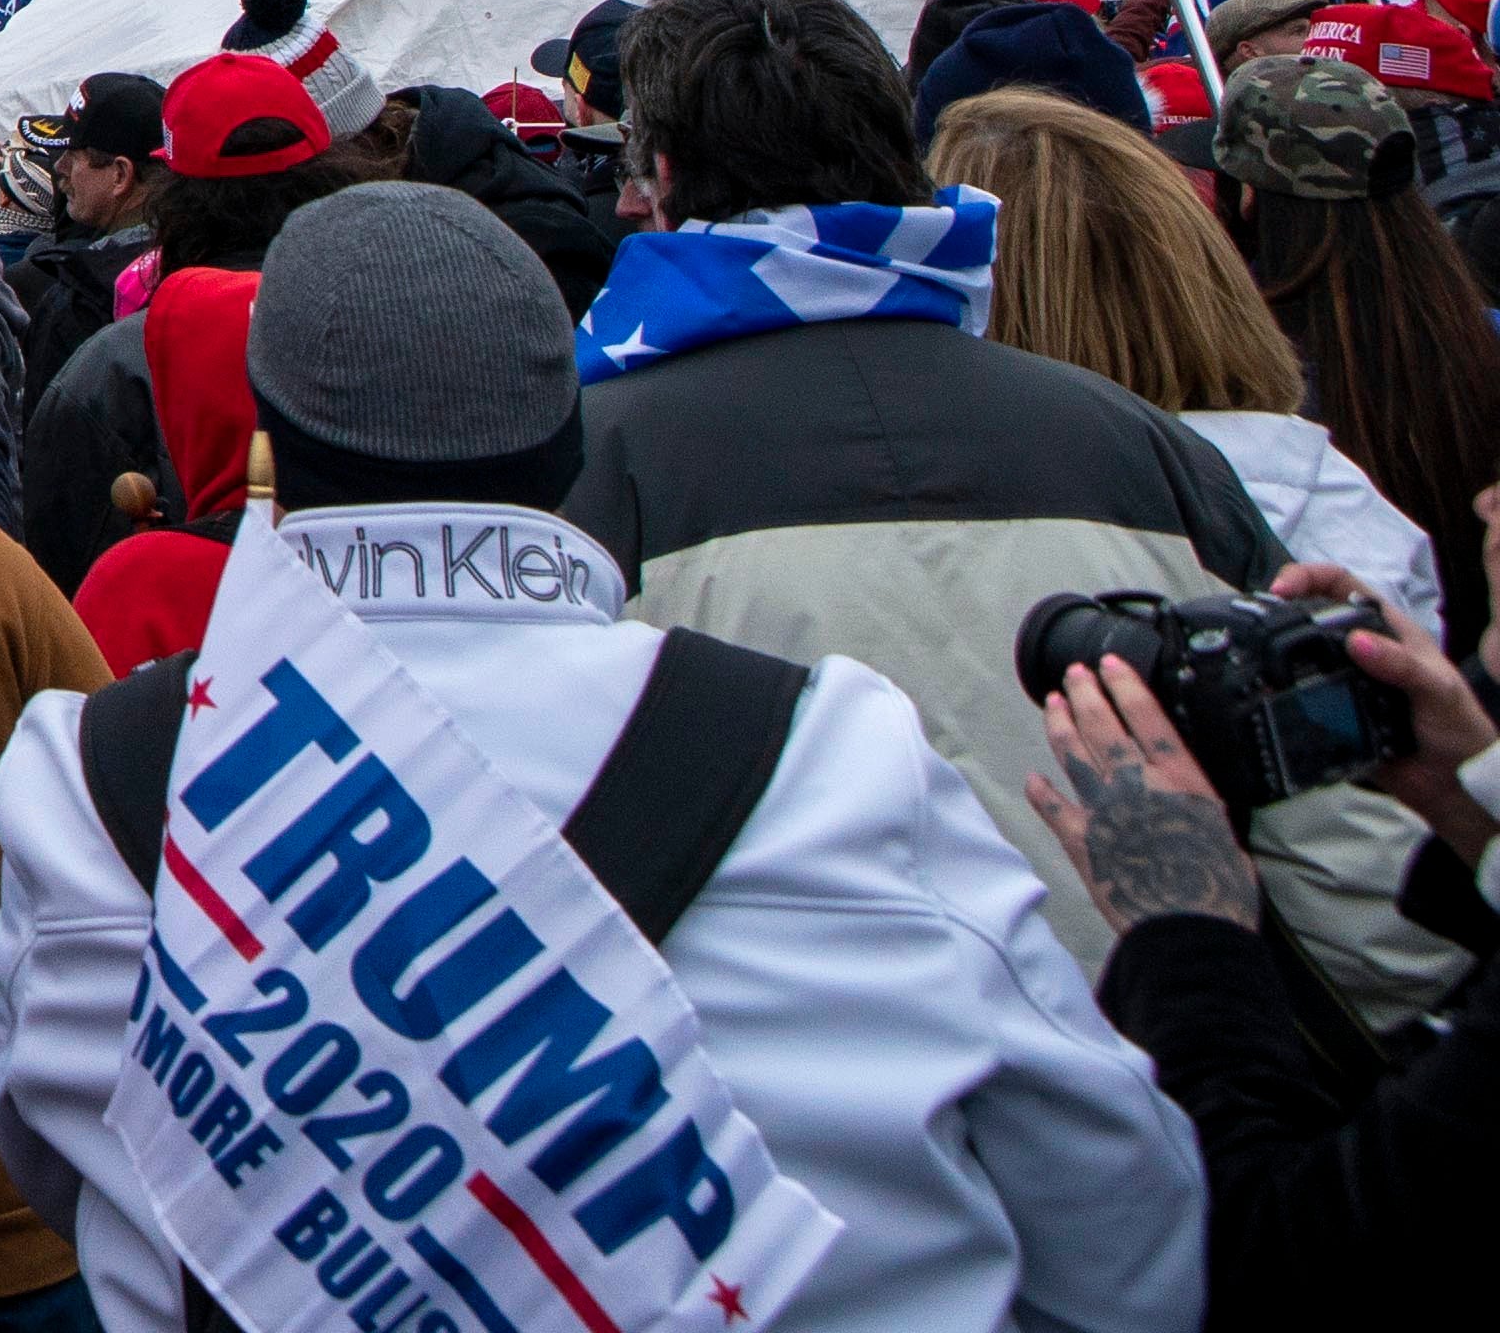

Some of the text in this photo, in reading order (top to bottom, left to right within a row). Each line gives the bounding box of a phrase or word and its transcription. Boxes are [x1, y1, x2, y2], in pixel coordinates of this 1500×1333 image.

[440, 522, 594, 608] Klein
[175, 658, 737, 1265] TRUMP
[131, 1003, 285, 1191] MORE
[200, 966, 466, 1223] 2020
